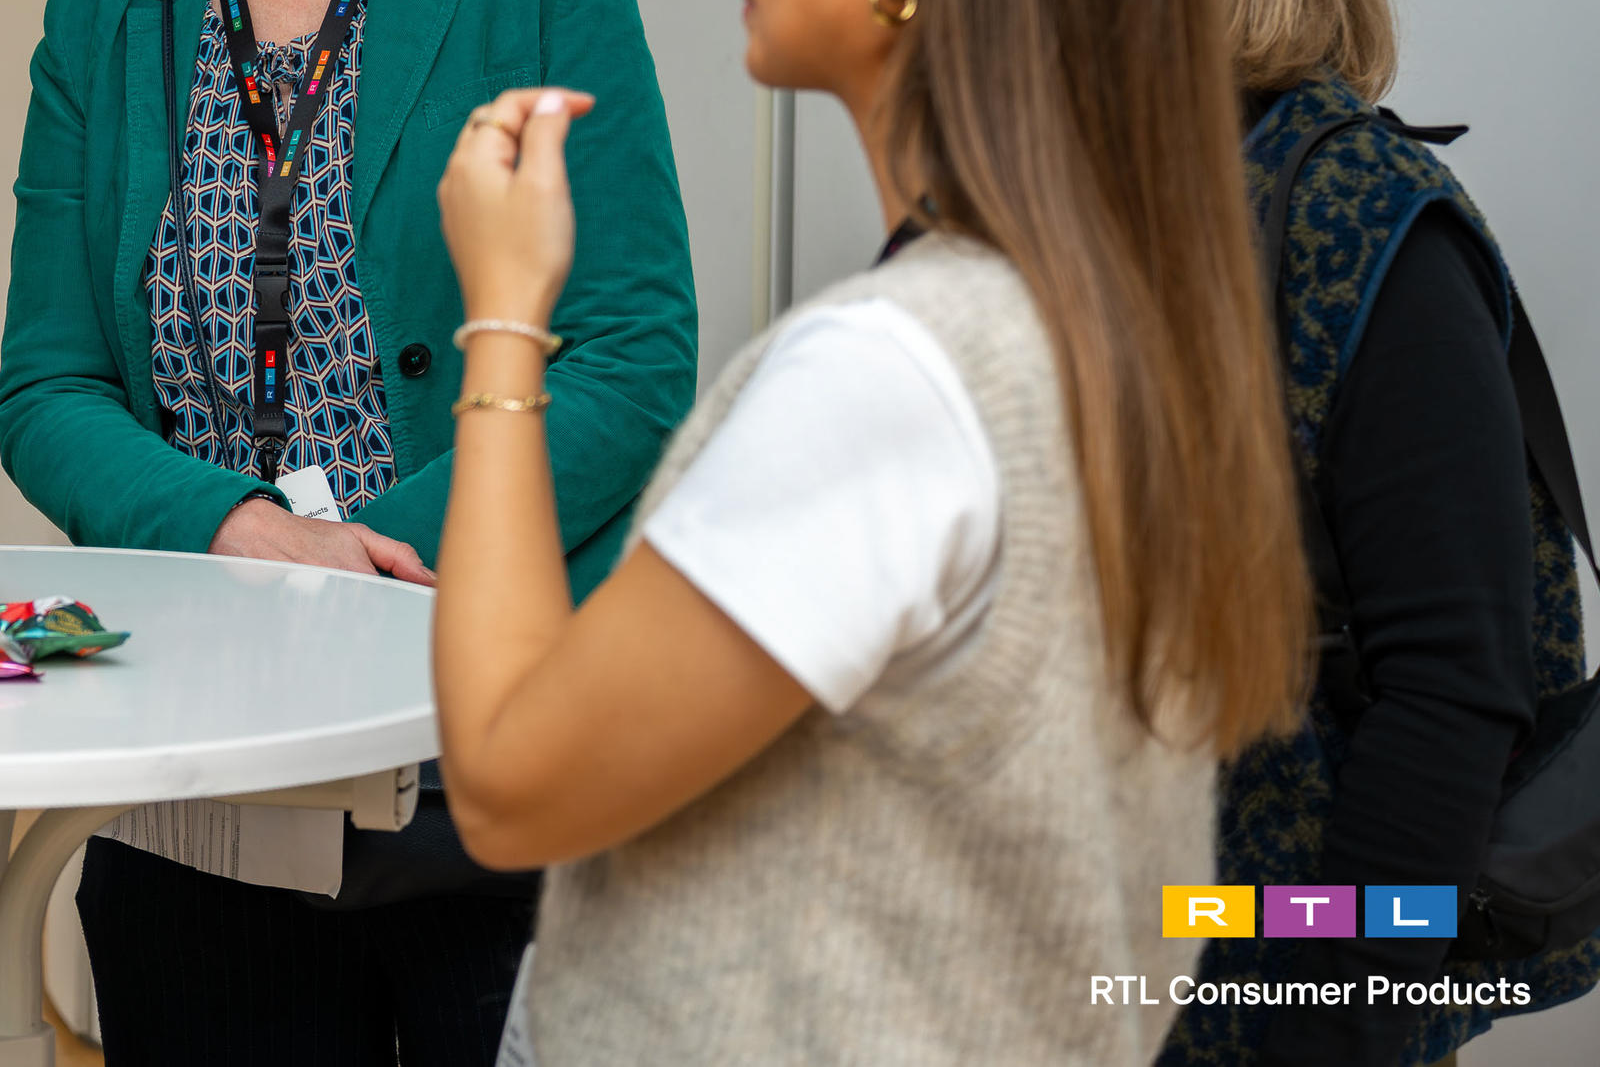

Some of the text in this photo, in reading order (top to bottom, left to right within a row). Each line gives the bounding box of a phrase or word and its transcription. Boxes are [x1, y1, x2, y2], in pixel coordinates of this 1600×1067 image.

[245, 65, 259, 102] RTL
[309, 53, 328, 92] RTL
[283, 133, 300, 174] RTL
[266, 354, 275, 400] RTL
